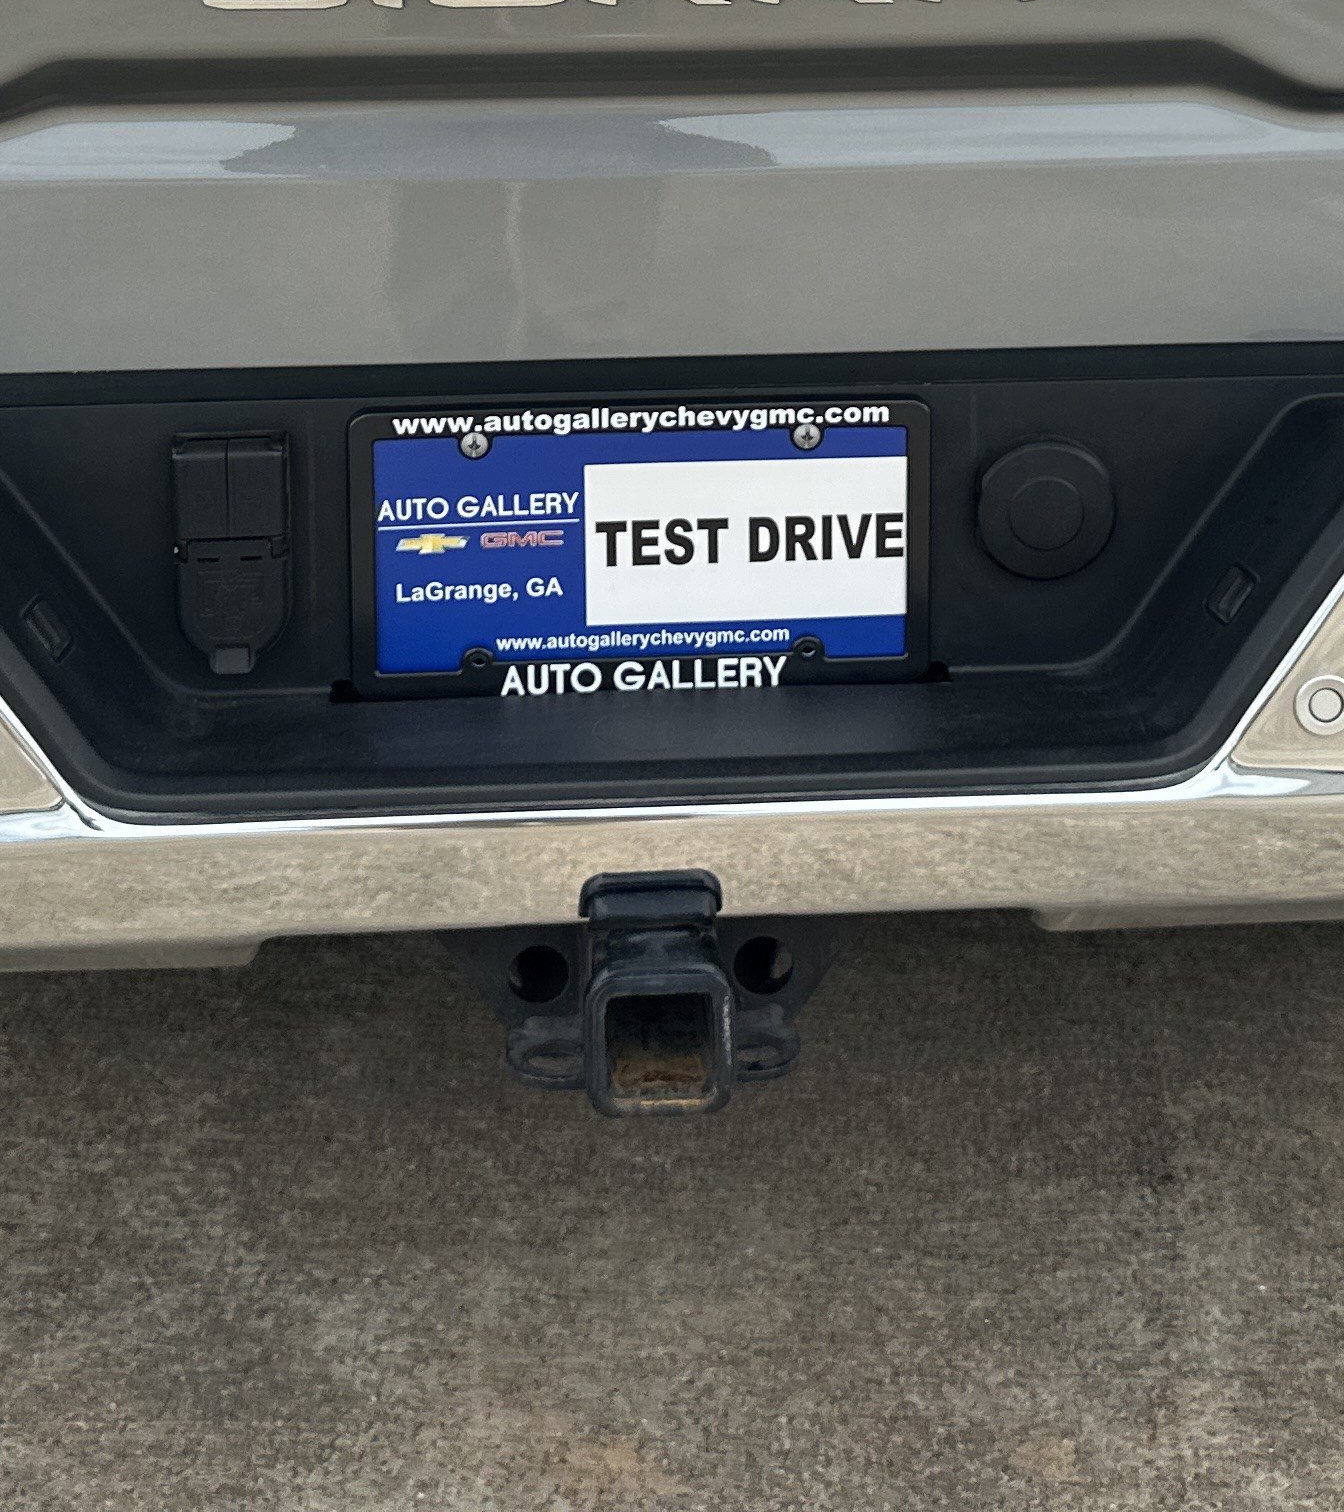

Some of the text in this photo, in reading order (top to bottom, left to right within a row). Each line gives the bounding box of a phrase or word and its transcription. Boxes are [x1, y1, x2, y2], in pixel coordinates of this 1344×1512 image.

[392, 405, 891, 435] www.autogallerychevygmc.com
[377, 491, 580, 522] AUTO GALLERY
[479, 529, 565, 549] GMC
[595, 512, 904, 568] TEST DRIVE
[396, 576, 564, 603] LaGrange, GA
[495, 626, 790, 652] www.autogallerychevygmc.com
[500, 654, 788, 697] AUTO GALLERY
